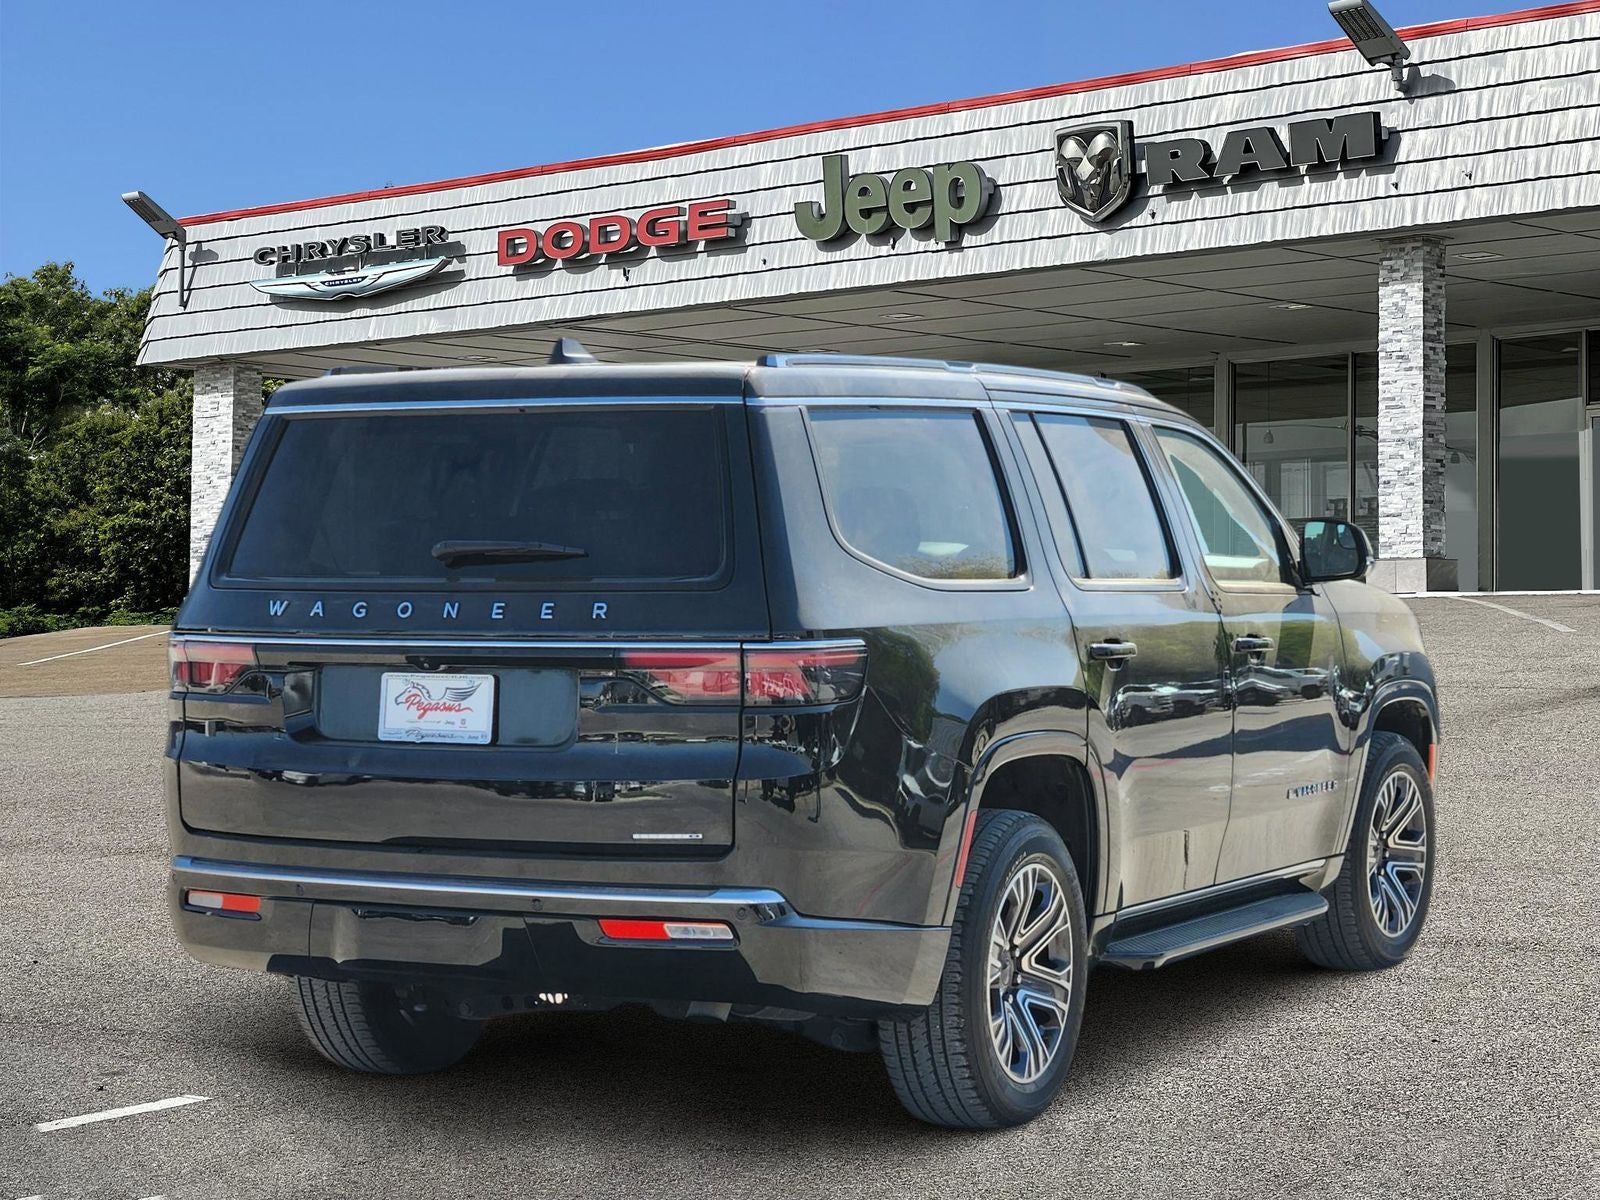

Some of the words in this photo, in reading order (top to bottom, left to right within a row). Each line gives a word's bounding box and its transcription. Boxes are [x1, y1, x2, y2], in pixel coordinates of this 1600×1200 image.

[1144, 112, 1380, 187] RAM
[794, 154, 987, 242] Jeep
[253, 225, 448, 266] CHRYSLER
[498, 199, 734, 267] DODGE
[324, 276, 363, 286] CHRYSLER
[268, 600, 608, 619] WAGONEER
[405, 693, 474, 720] Pegasus
